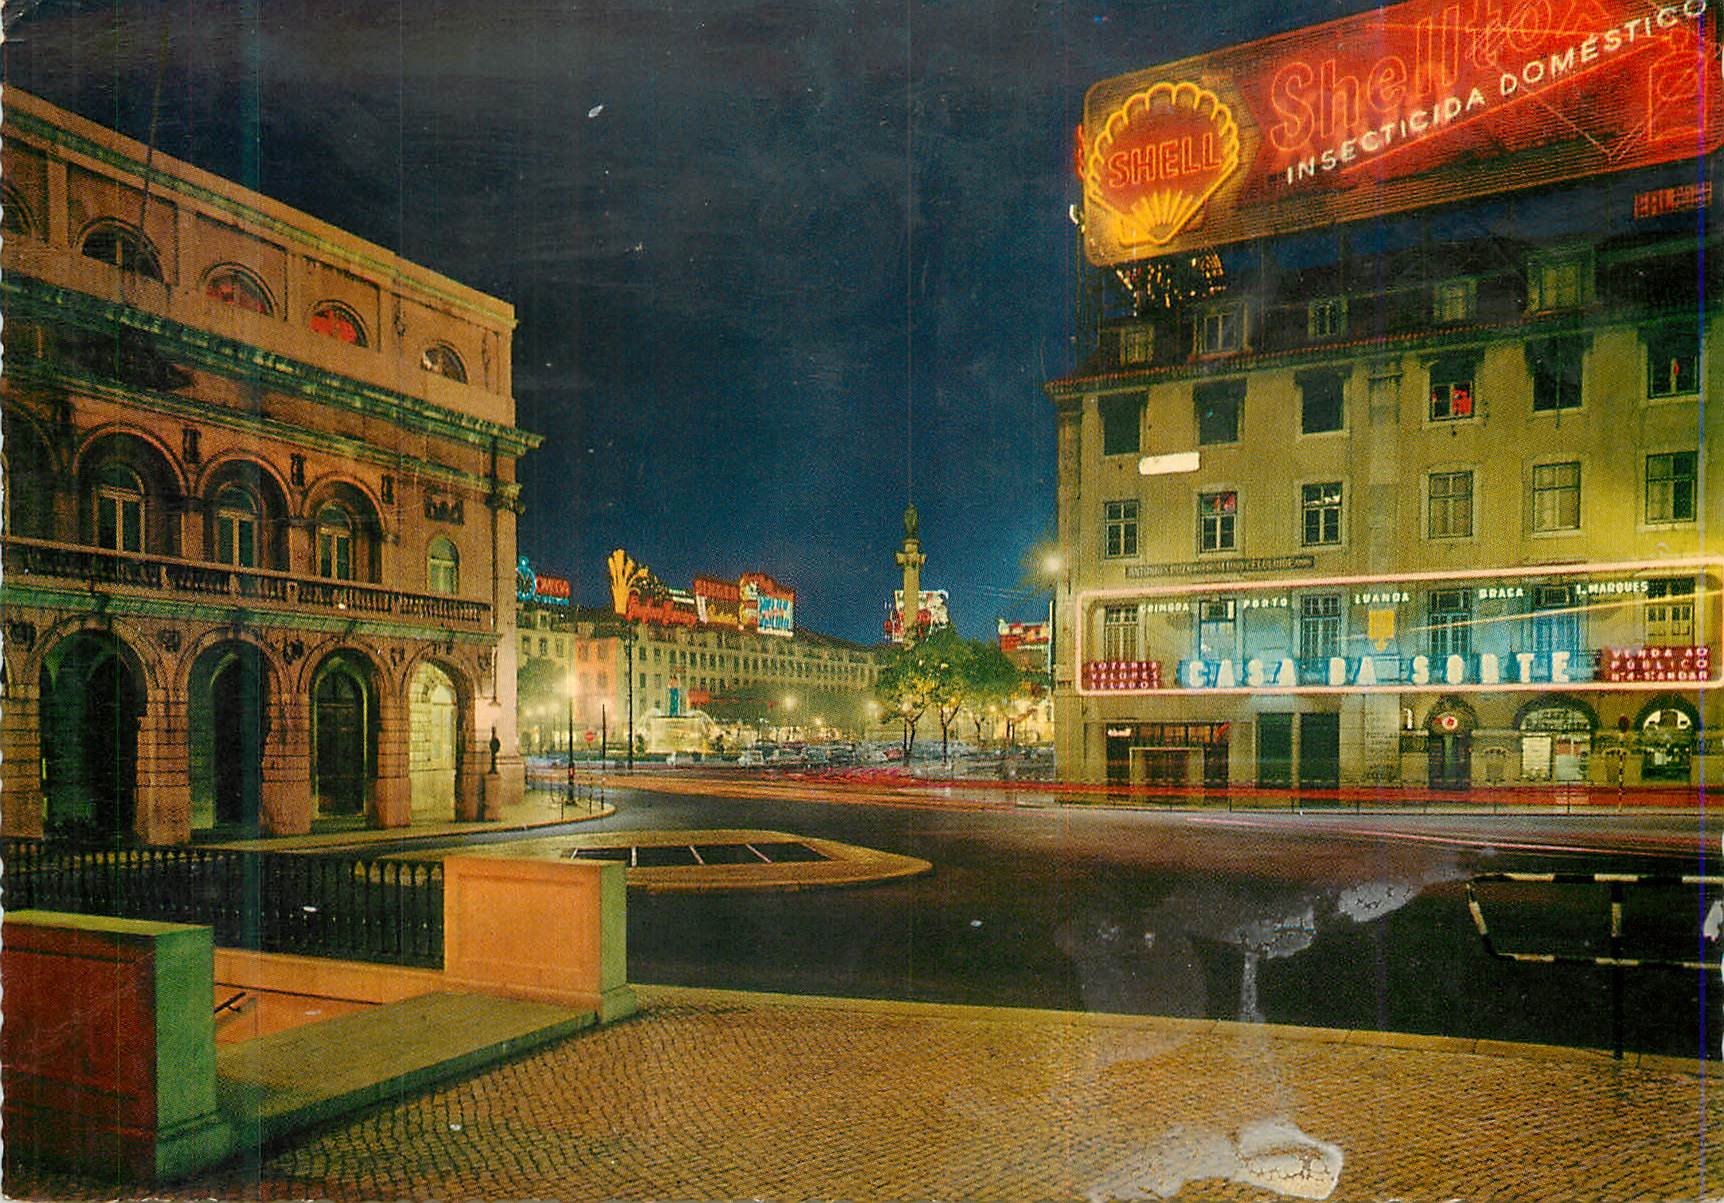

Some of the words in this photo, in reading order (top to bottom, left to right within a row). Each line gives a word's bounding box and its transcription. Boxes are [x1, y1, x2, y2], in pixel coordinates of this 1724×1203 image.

[1286, 87, 1486, 185] INSECTICIDA
[1500, 0, 1706, 96] DOMÉSTICO
[1107, 131, 1222, 188] SHELL
[1242, 597, 1288, 609] PORTO
[1354, 591, 1410, 605] LUANDA
[1138, 602, 1190, 613] COIMBRA
[1684, 647, 1709, 658] AO
[1186, 656, 1297, 688] CASA
[1328, 656, 1377, 686] DA
[1411, 651, 1571, 685] SORTE
